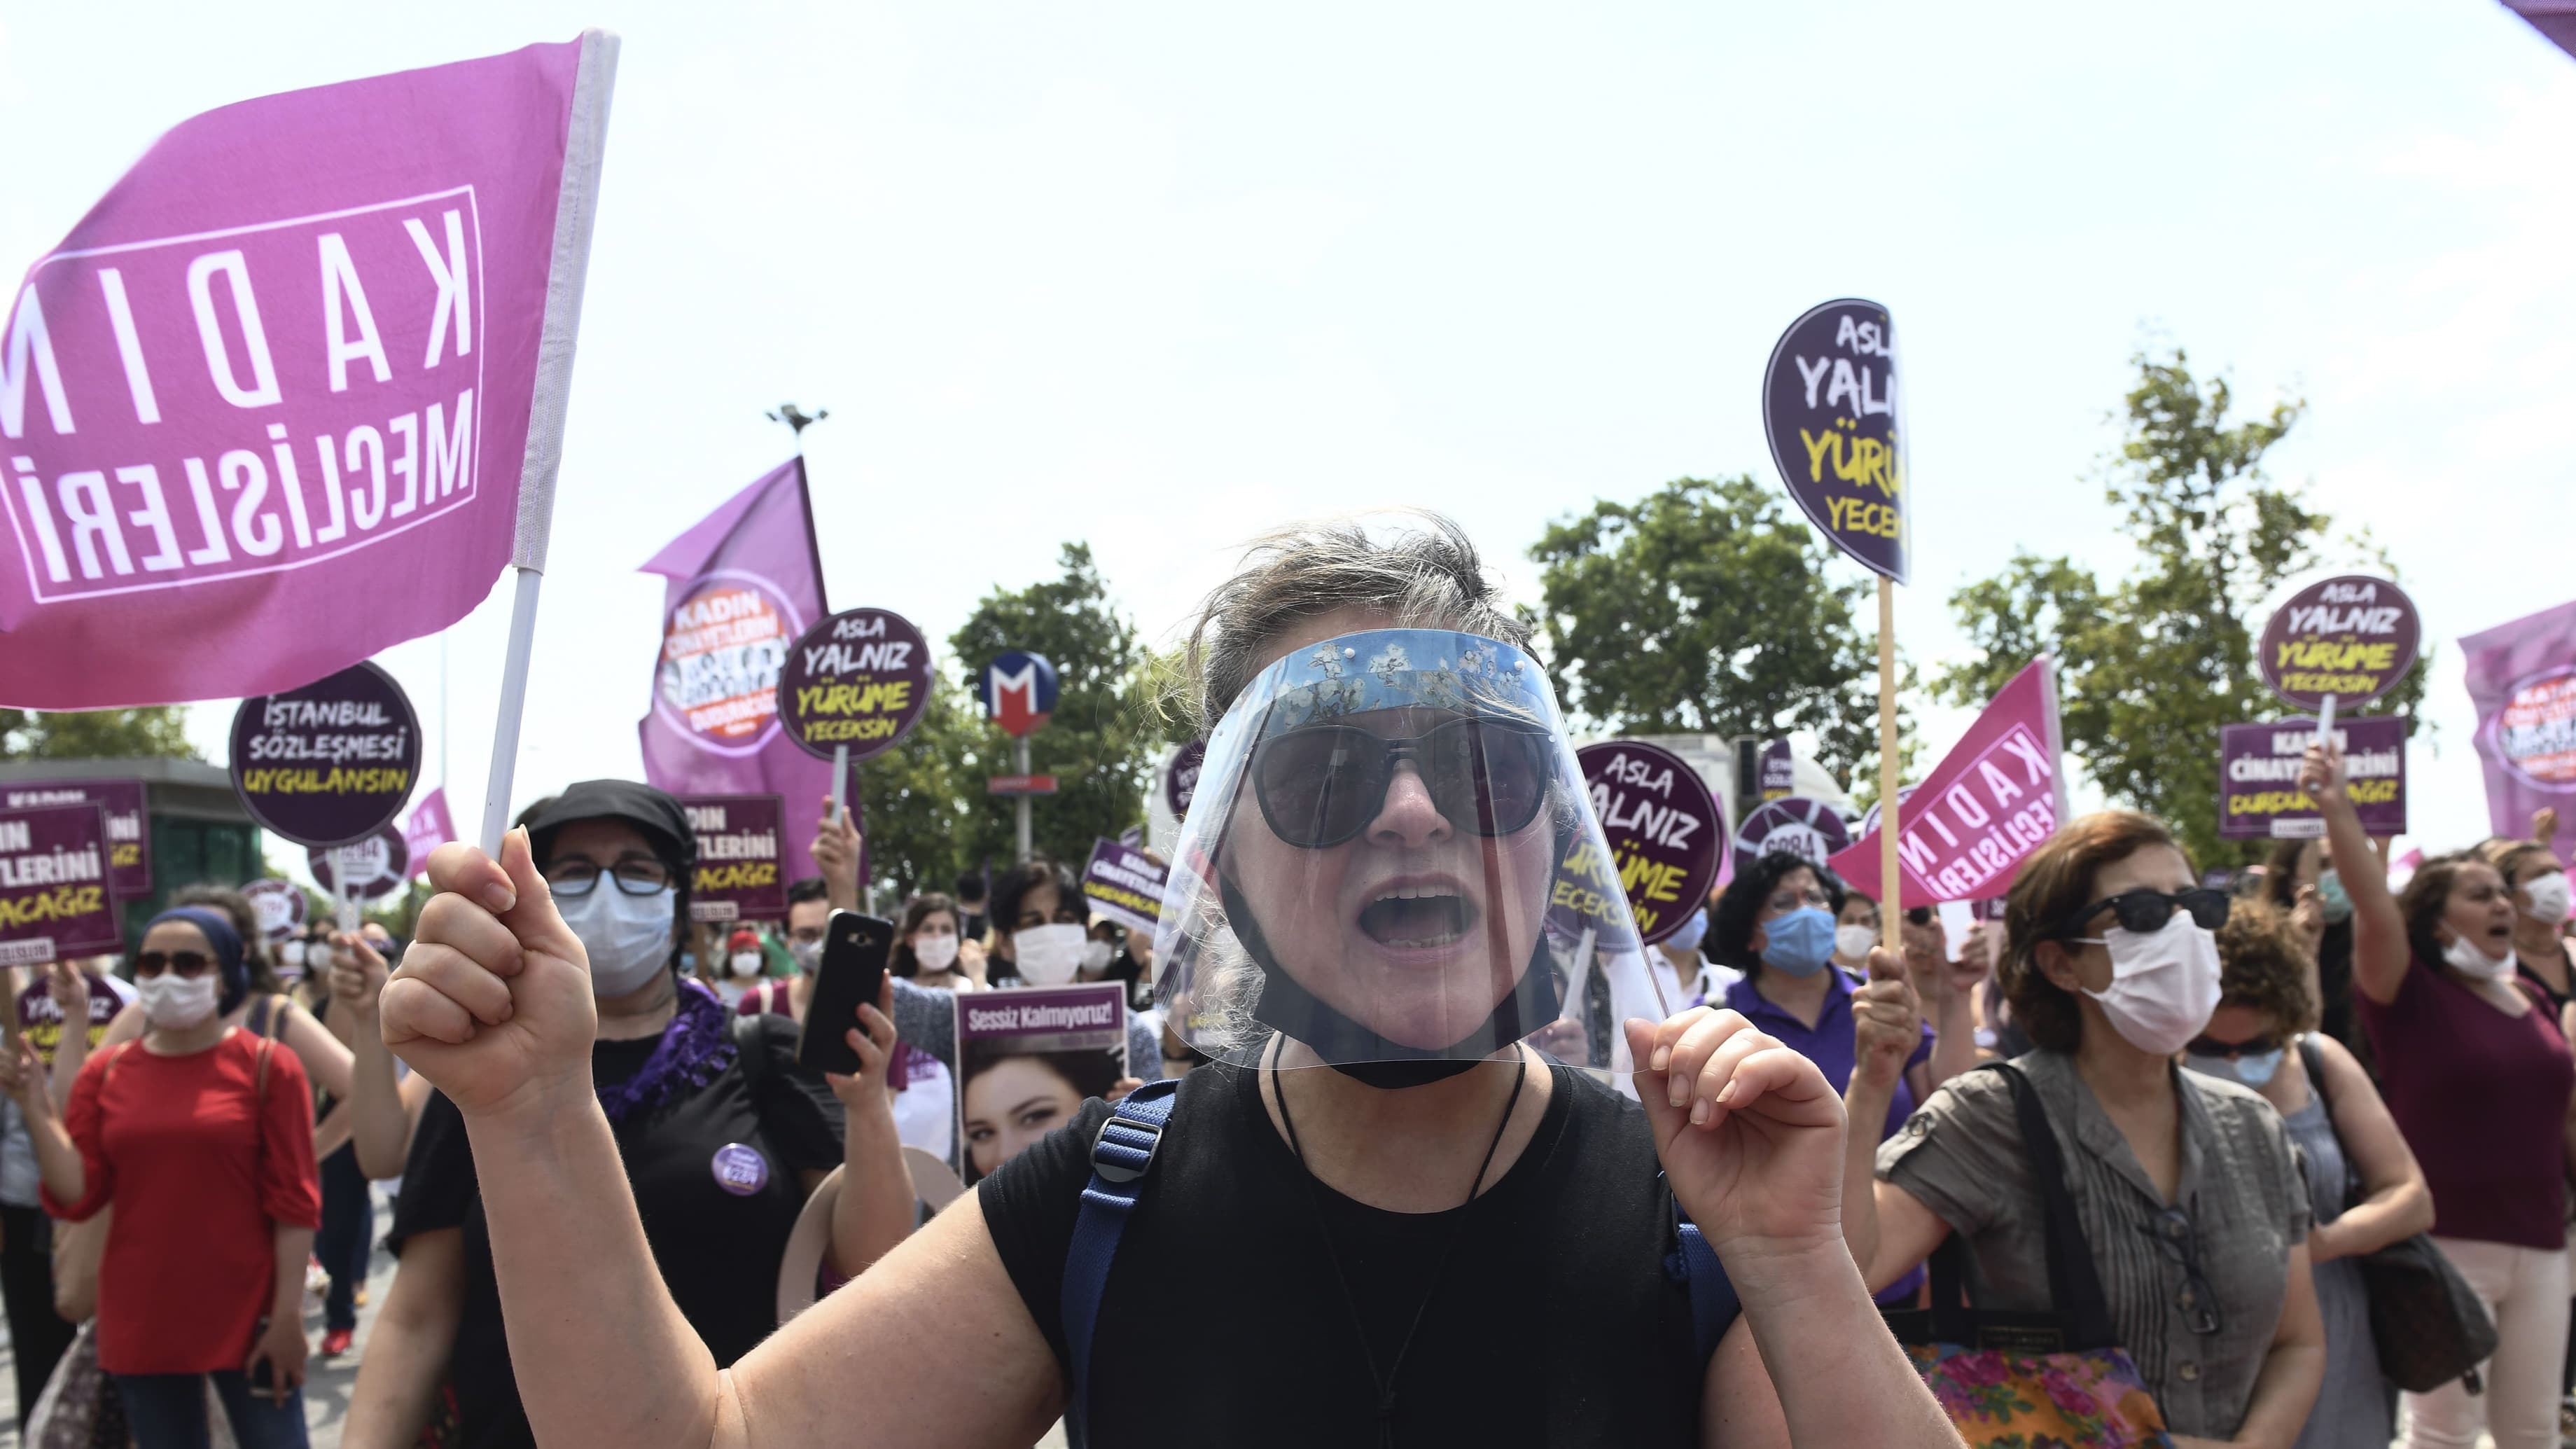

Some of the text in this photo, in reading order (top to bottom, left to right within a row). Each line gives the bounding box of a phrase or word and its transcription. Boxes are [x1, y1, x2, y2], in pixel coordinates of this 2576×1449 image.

[674, 590, 761, 630] KADIN
[2320, 583, 2376, 605] ASLA
[832, 617, 886, 640] ASLA
[2288, 604, 2402, 635] YALNIZ
[804, 641, 913, 677] YALNIZ
[2276, 635, 2397, 672] YÜRÜME
[796, 674, 912, 718] YÜRÜME
[989, 663, 1038, 717] M
[263, 695, 391, 728] İSTANBUL
[803, 714, 898, 742] YECEKSİN
[249, 726, 408, 765] SÖZLEŞMESİ
[244, 768, 408, 796] UYGULANSIN
[1606, 753, 1673, 800] ASLA
[1586, 772, 1701, 851] ALNIZ
[968, 1001, 1113, 1032] Sessiz Kalmıyoruz!
